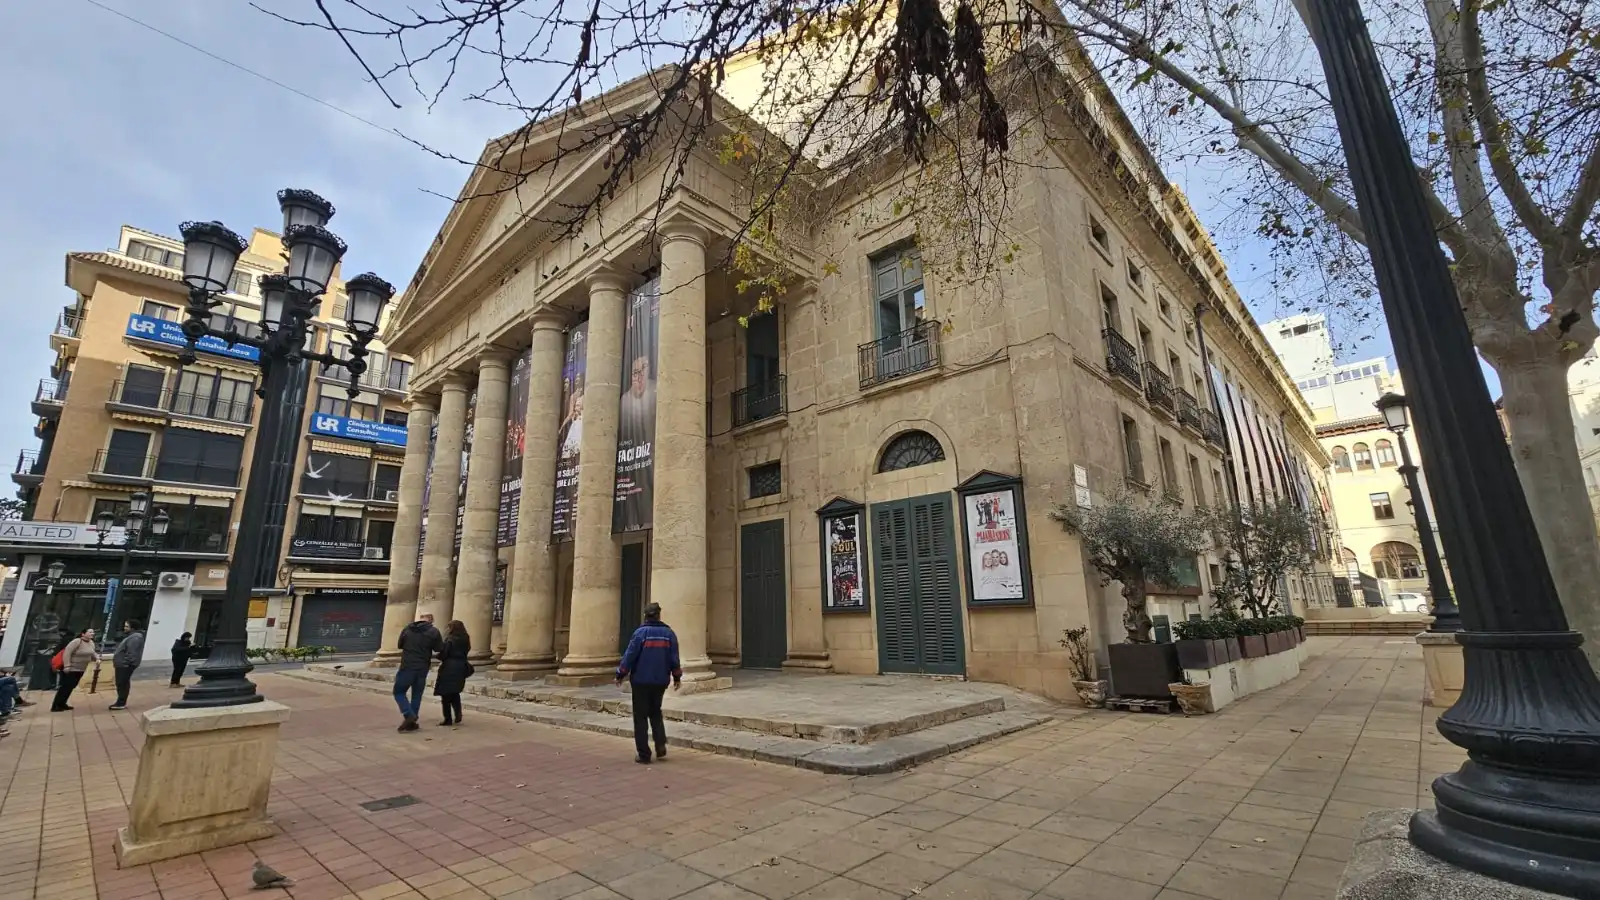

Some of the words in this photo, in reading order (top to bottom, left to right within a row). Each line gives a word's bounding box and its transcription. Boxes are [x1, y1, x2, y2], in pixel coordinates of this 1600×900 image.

[194, 340, 250, 356] istaherosa
[371, 423, 408, 435] Vistahermo
[3, 525, 73, 539] ALTED
[832, 541, 856, 553] SOUL
